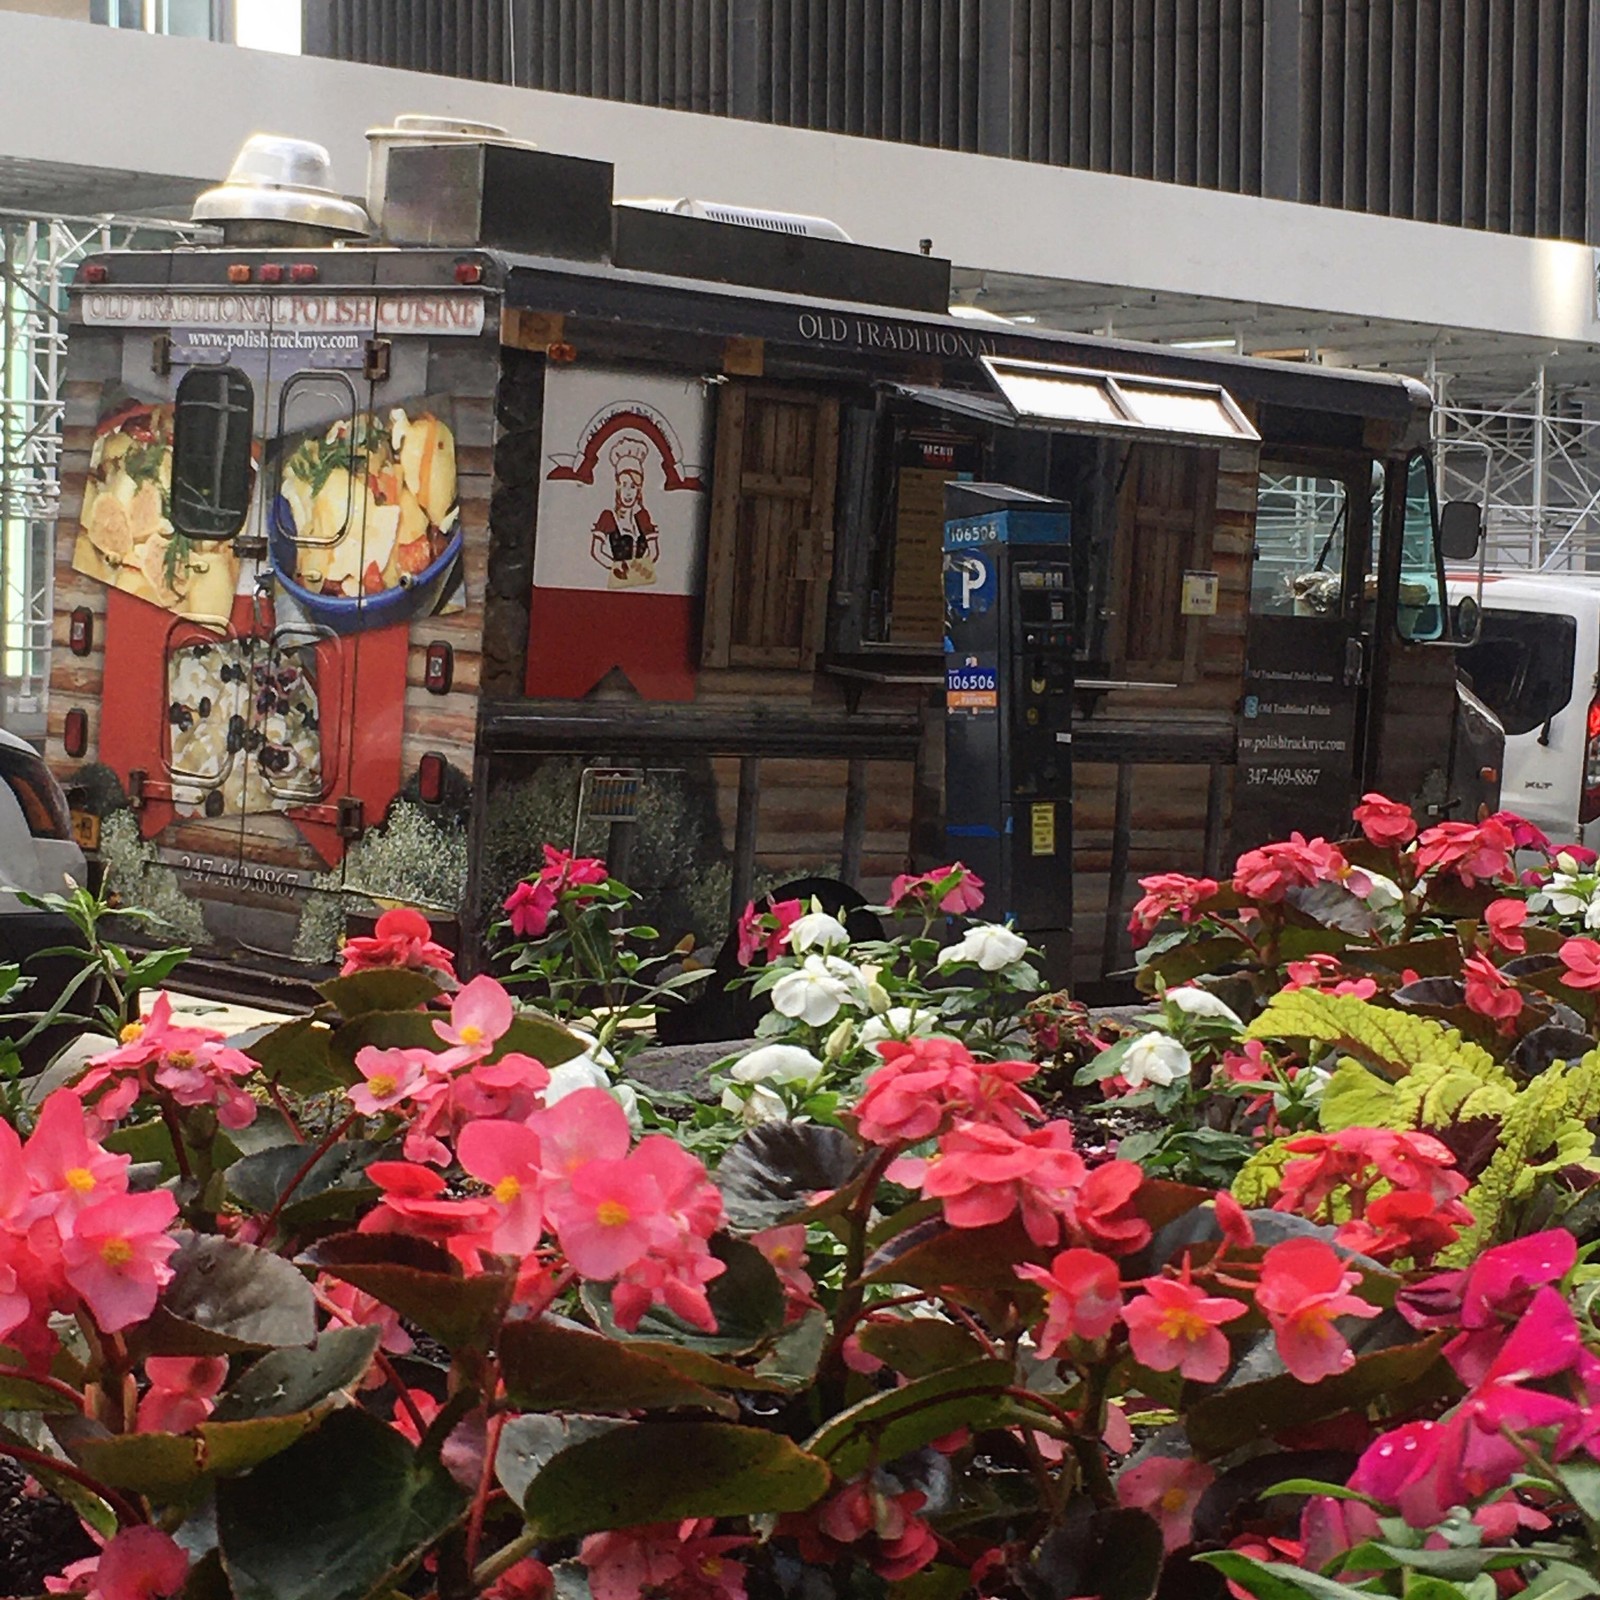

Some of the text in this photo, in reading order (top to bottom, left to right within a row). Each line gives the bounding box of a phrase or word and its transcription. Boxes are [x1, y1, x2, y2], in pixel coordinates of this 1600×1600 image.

[89, 295, 480, 329] OLD TRADITIONAL POLISH CUISINE
[798, 313, 847, 342] OLD
[188, 329, 359, 353] www.polishtrucknyc.com
[948, 675, 995, 690] 106506
[1247, 767, 1320, 785] 347-469-8867
[1524, 781, 1553, 790] XLT
